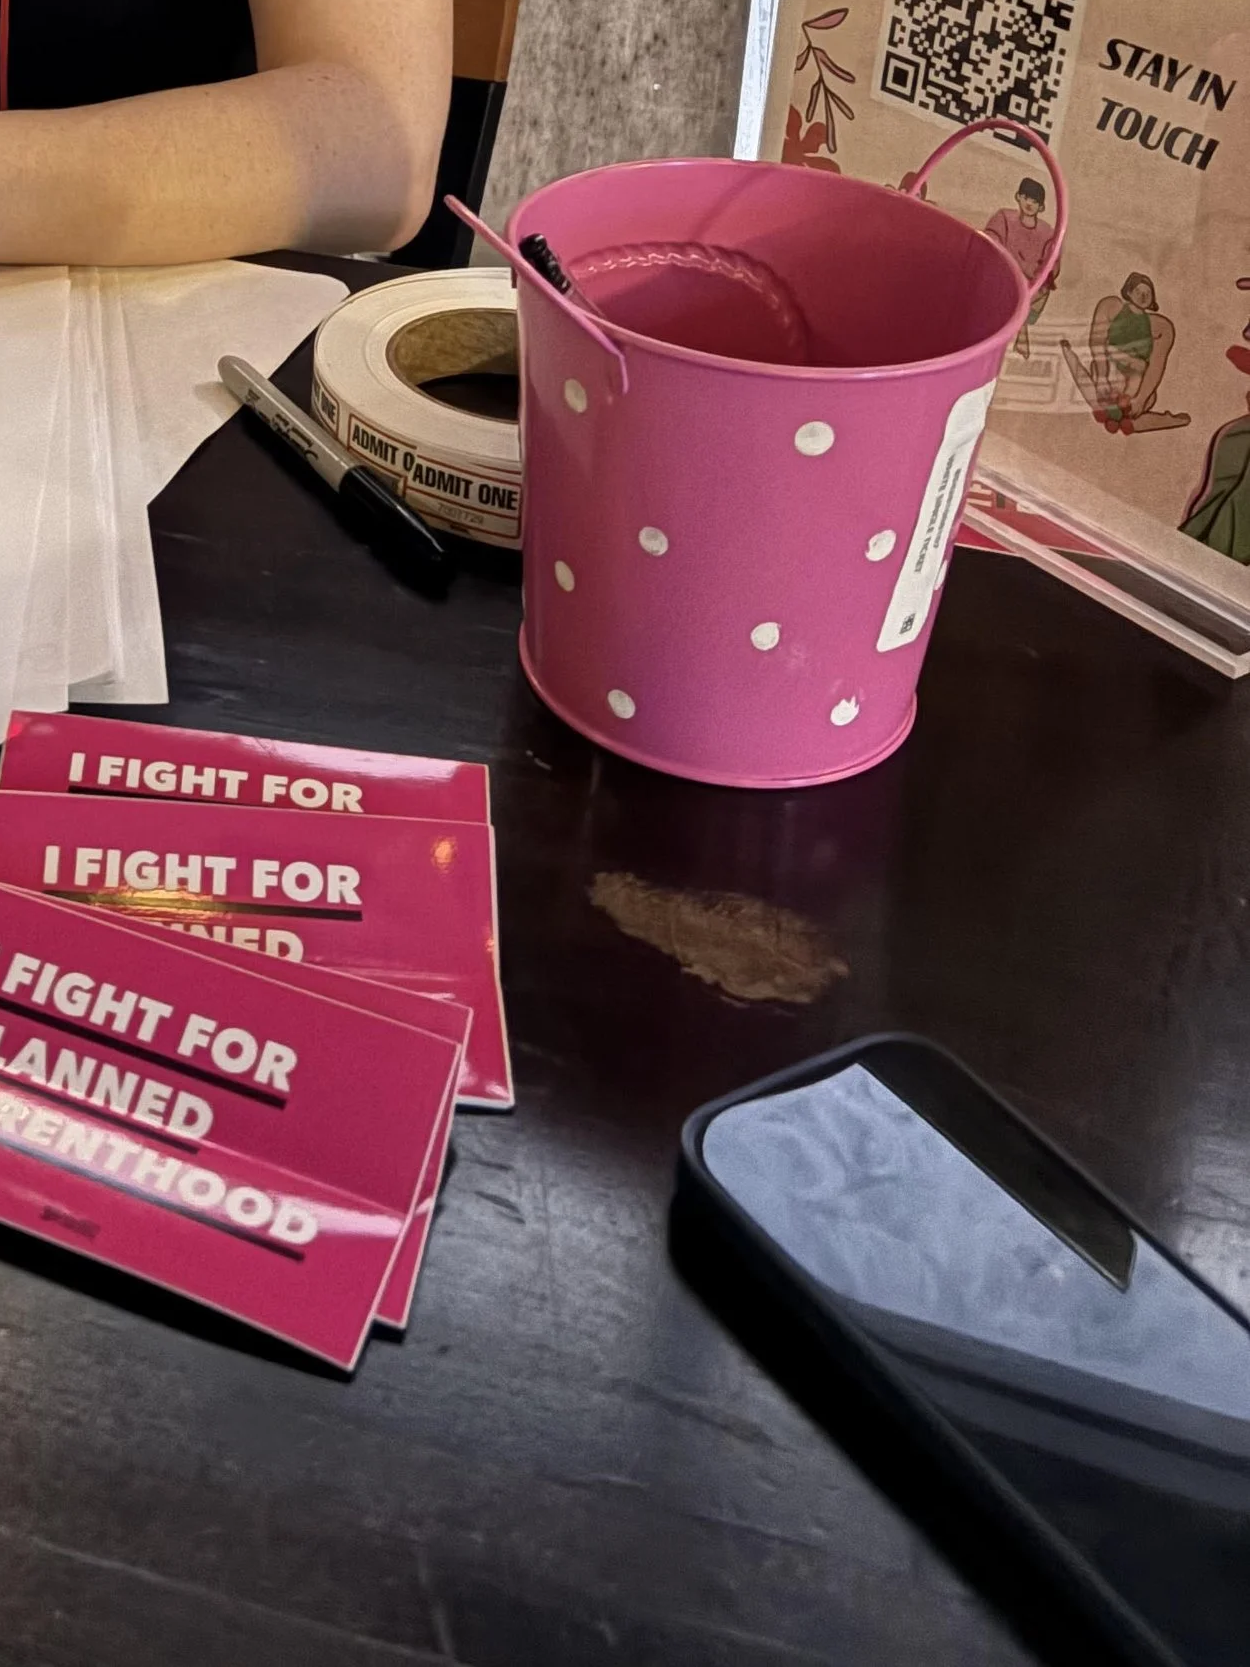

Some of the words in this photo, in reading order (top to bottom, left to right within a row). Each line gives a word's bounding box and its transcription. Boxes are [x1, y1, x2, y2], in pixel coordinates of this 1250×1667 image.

[1098, 38, 1193, 93] STAY
[1188, 69, 1237, 111] IN
[1096, 97, 1220, 171] TOUCH
[352, 424, 399, 466] ADMIT
[413, 465, 474, 500] ADMIT
[478, 483, 519, 511] ONE
[69, 752, 86, 782] I
[97, 755, 249, 799] FIGHT
[262, 775, 364, 813] FOR
[43, 845, 60, 884] I
[74, 847, 237, 896] FIGHT
[252, 859, 362, 905] FOR
[1, 953, 173, 1043] FIGHT
[177, 1015, 298, 1092] FOR
